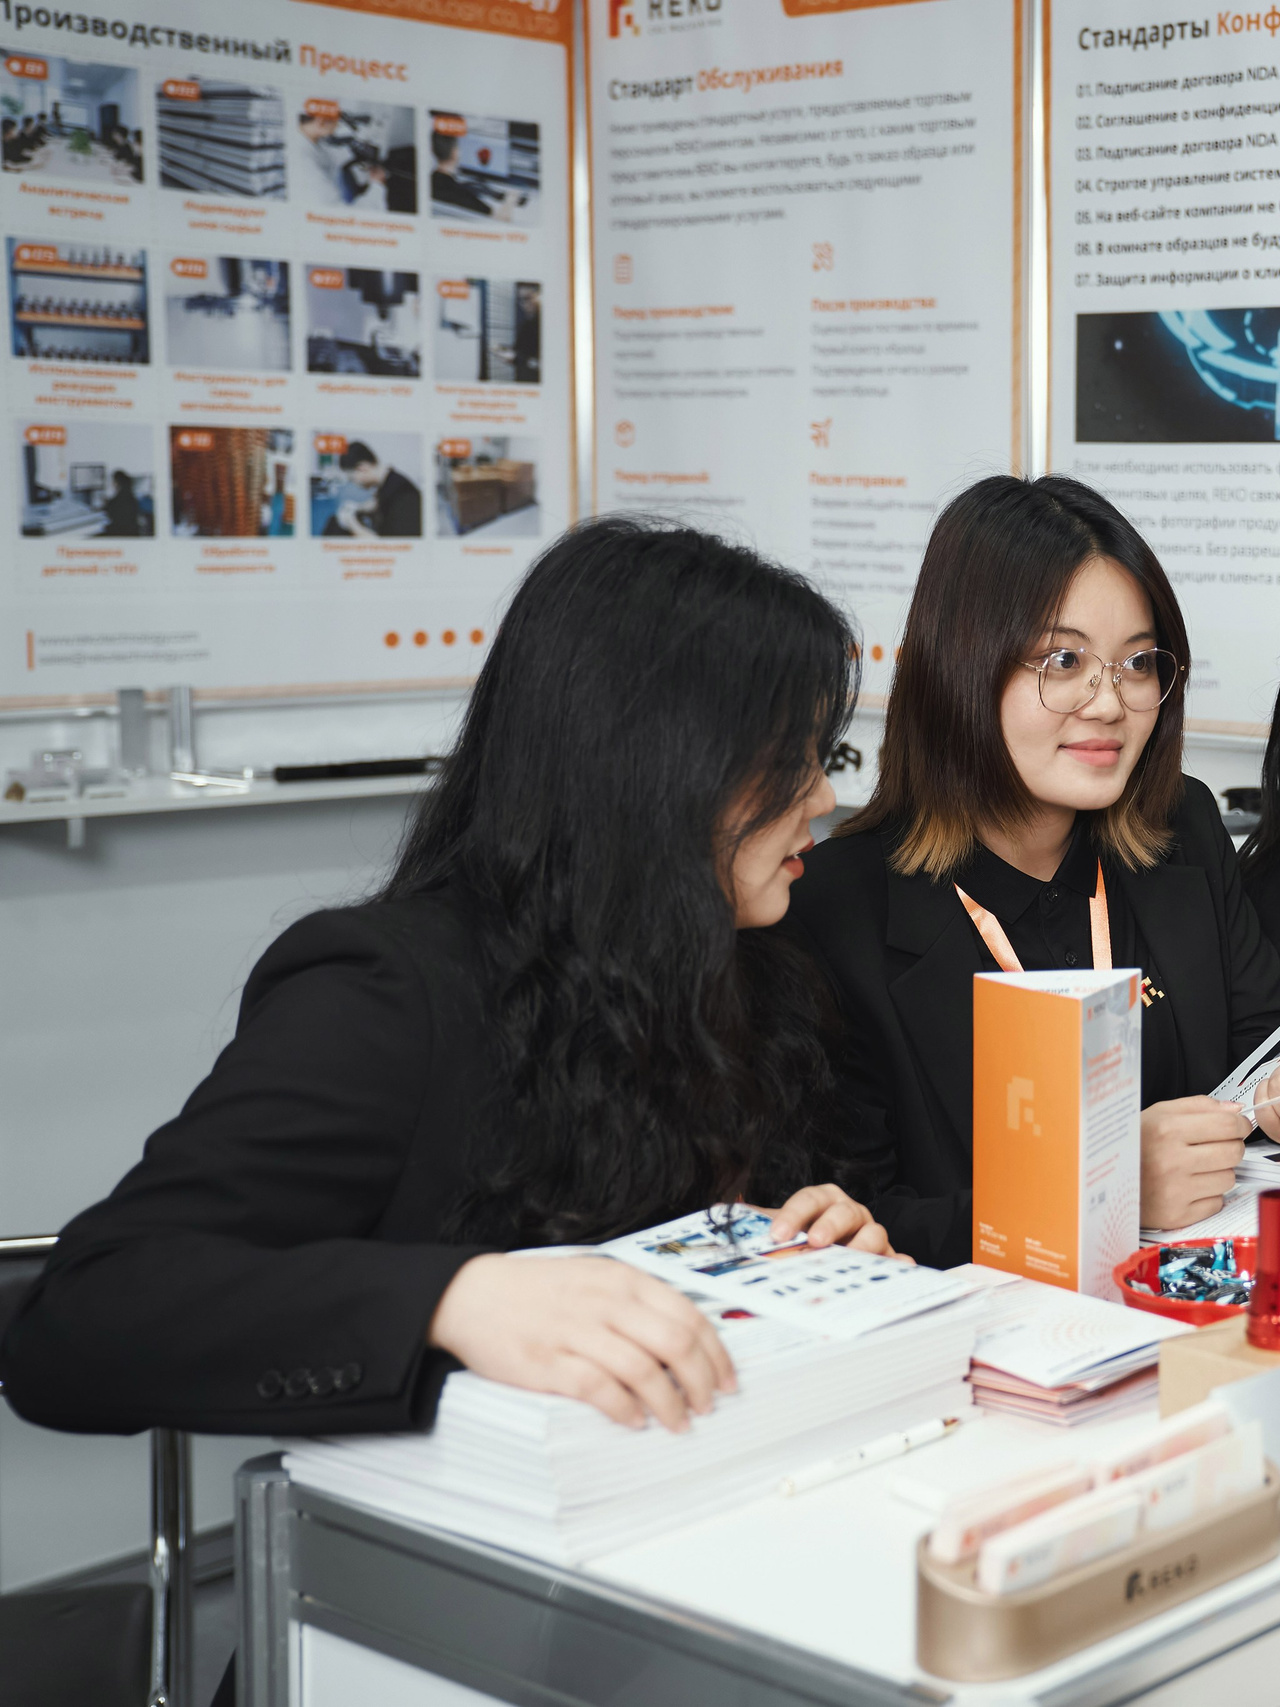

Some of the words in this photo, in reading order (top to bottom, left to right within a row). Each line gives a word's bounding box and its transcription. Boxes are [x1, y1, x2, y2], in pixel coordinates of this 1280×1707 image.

[1078, 18, 1210, 50] Стандарты
[299, 44, 409, 82] Процесс
[608, 74, 693, 103] Стандарт
[697, 58, 845, 94] Обслуживания
[1095, 79, 1179, 96] Подписание
[1181, 72, 1244, 89] договора
[1246, 65, 1279, 80] NDA
[1096, 112, 1178, 127] Соглашение
[1182, 110, 1189, 121] о
[1096, 144, 1178, 160] Подписание
[1181, 138, 1243, 155] договора
[1246, 132, 1278, 147] NDA
[1096, 177, 1148, 192] Строгое
[1150, 172, 1231, 190] управление
[1096, 211, 1113, 223] На
[1116, 206, 1181, 222] веб-сайте
[1184, 203, 1254, 217] компании
[1257, 202, 1275, 213] не
[1095, 241, 1107, 254] В
[1106, 241, 1163, 254] комнате
[1166, 237, 1229, 252] образцов
[1232, 236, 1248, 247] не
[1096, 273, 1147, 287] Защита
[1149, 269, 1239, 285] информации
[1242, 268, 1250, 280] о
[1102, 460, 1180, 475] необходимо
[1182, 462, 1272, 474] использовать
[1170, 489, 1209, 502] целях,
[1212, 487, 1249, 502] REKO
[1161, 516, 1237, 530] фотографии
[1206, 542, 1230, 556] Без
[1226, 572, 1274, 584] клиента
